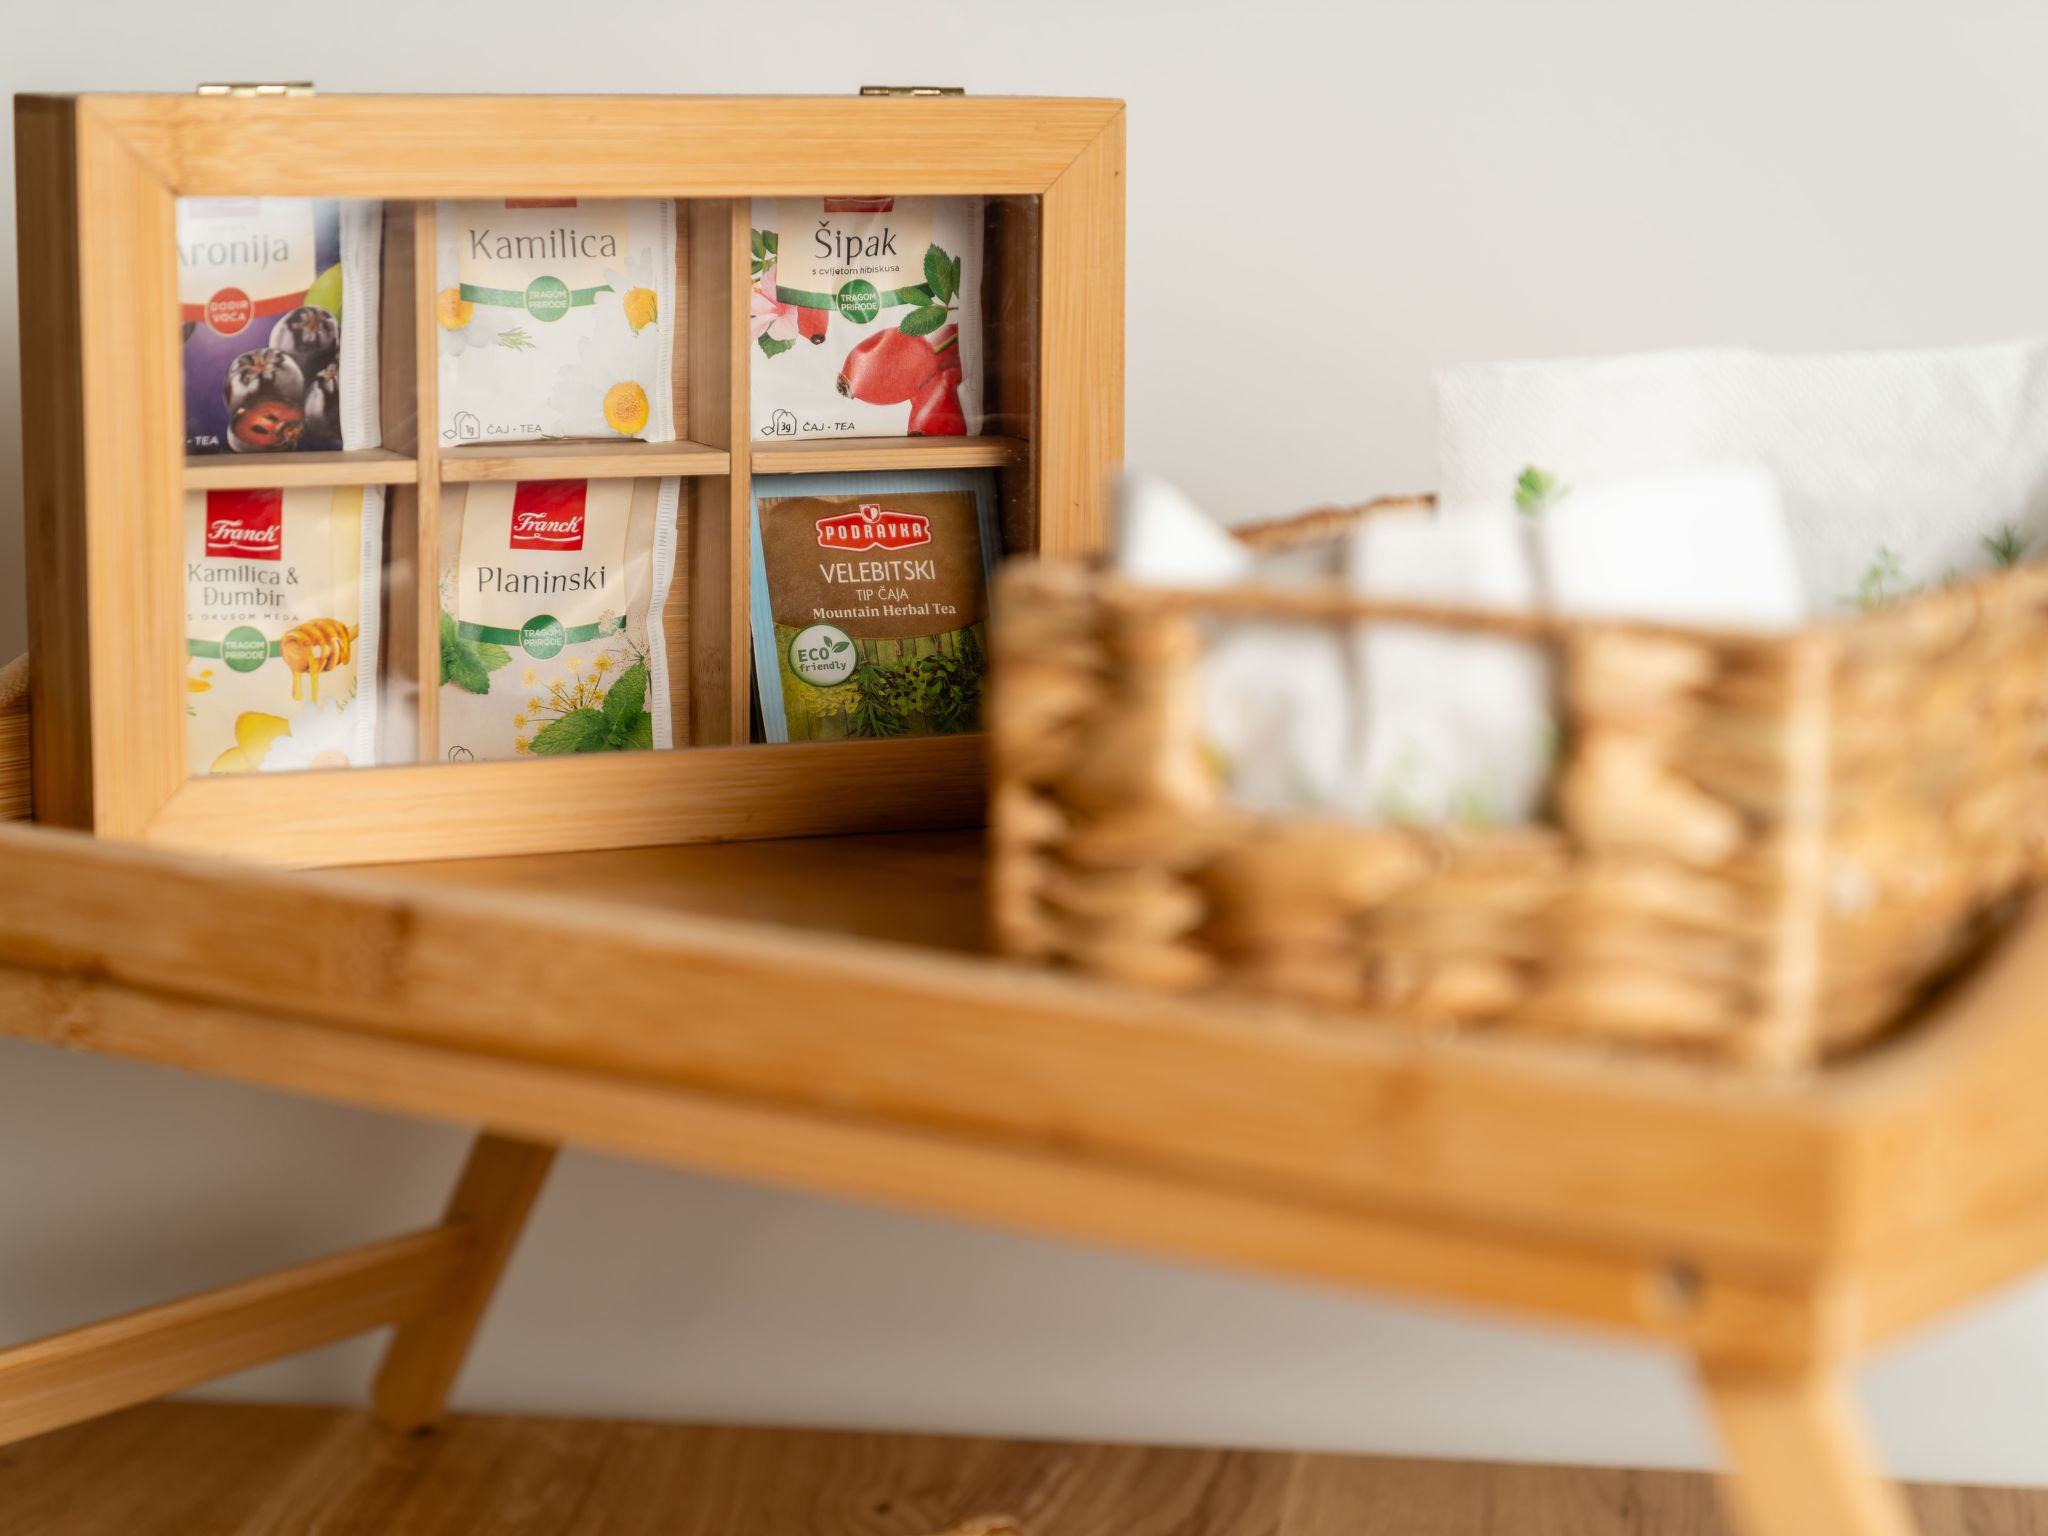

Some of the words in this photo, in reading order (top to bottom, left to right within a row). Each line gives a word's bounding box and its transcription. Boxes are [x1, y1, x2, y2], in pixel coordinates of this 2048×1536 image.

[468, 228, 617, 260] Kamilica
[815, 220, 897, 265] Šipak
[818, 267, 859, 277] cvijetom
[860, 264, 900, 275] hibiskusa
[528, 290, 567, 300] TRAGOM
[841, 293, 876, 302] TRAGOM
[528, 300, 568, 309] PRIRODE
[841, 302, 878, 311] PRIRODE
[487, 423, 509, 434] ČAJ
[520, 424, 543, 433] TEA
[781, 422, 791, 432] 3g
[802, 421, 825, 432] ČAJ
[835, 423, 855, 431] TEA
[194, 435, 219, 446] TEA
[513, 512, 583, 534] Franck
[207, 519, 281, 543] Franck
[826, 523, 923, 540] PODRAVKA
[188, 563, 281, 585] Kamilica
[286, 567, 300, 585] &
[819, 559, 936, 584] VELEBITSKI
[477, 566, 606, 594] Planinski
[203, 587, 285, 607] Đumbir
[856, 588, 874, 601] TIP
[877, 585, 909, 601] ČAJA
[812, 605, 880, 619] Mountain
[884, 604, 930, 617] Herbal
[932, 602, 956, 615] Tea
[201, 613, 256, 621] OKUSOM
[264, 613, 299, 621] MEDA
[523, 629, 561, 638] TRAGOM
[225, 641, 264, 650] TRAGOM
[523, 638, 562, 647] PRIRODE
[797, 647, 829, 662] ECO
[799, 661, 847, 673] friendly
